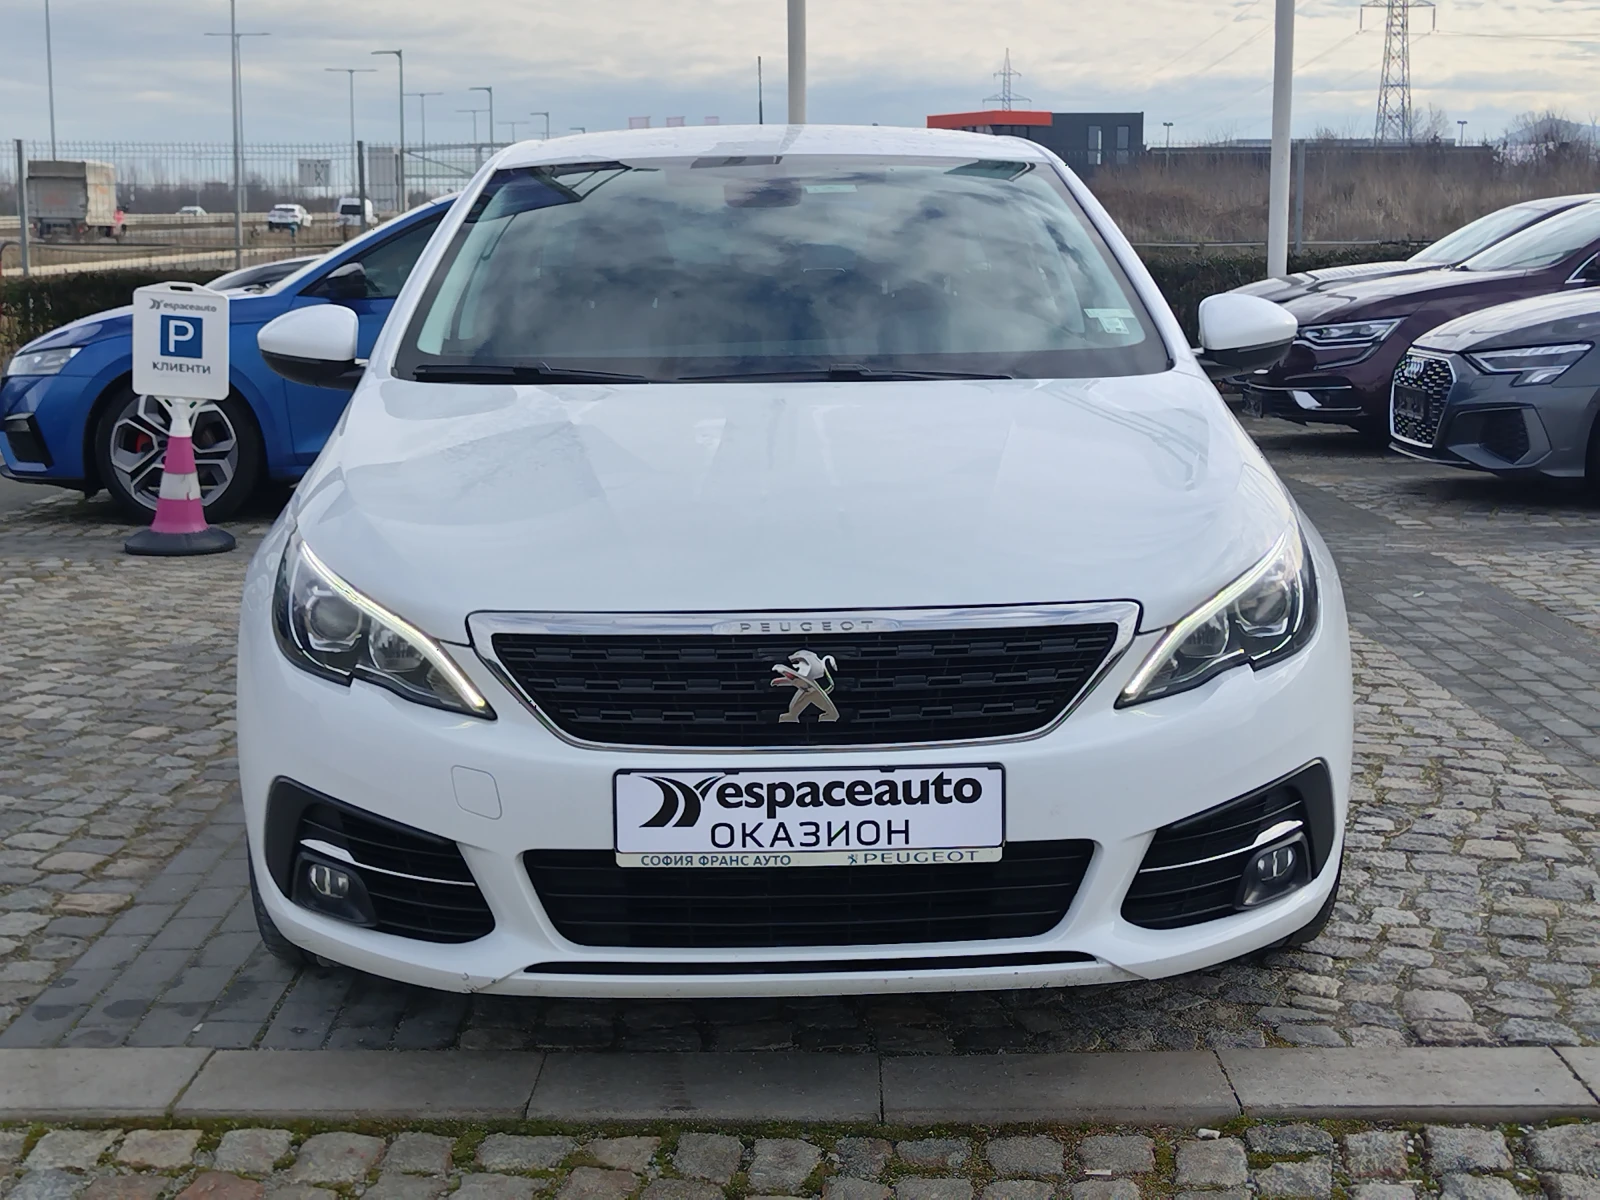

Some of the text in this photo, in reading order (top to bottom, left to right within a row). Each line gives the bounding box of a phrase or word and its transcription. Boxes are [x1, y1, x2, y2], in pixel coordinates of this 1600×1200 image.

[163, 301, 217, 312] espaceauto
[168, 319, 195, 353] P
[152, 361, 211, 374] КЛИЕНТИ
[739, 620, 874, 633] PEUGEOT
[716, 771, 982, 819] espaceauto
[710, 819, 910, 849] ОКАЗИОН
[640, 854, 792, 867] СОФИЯ ФРАНС АУТО
[863, 850, 980, 864] PEUGEOT
